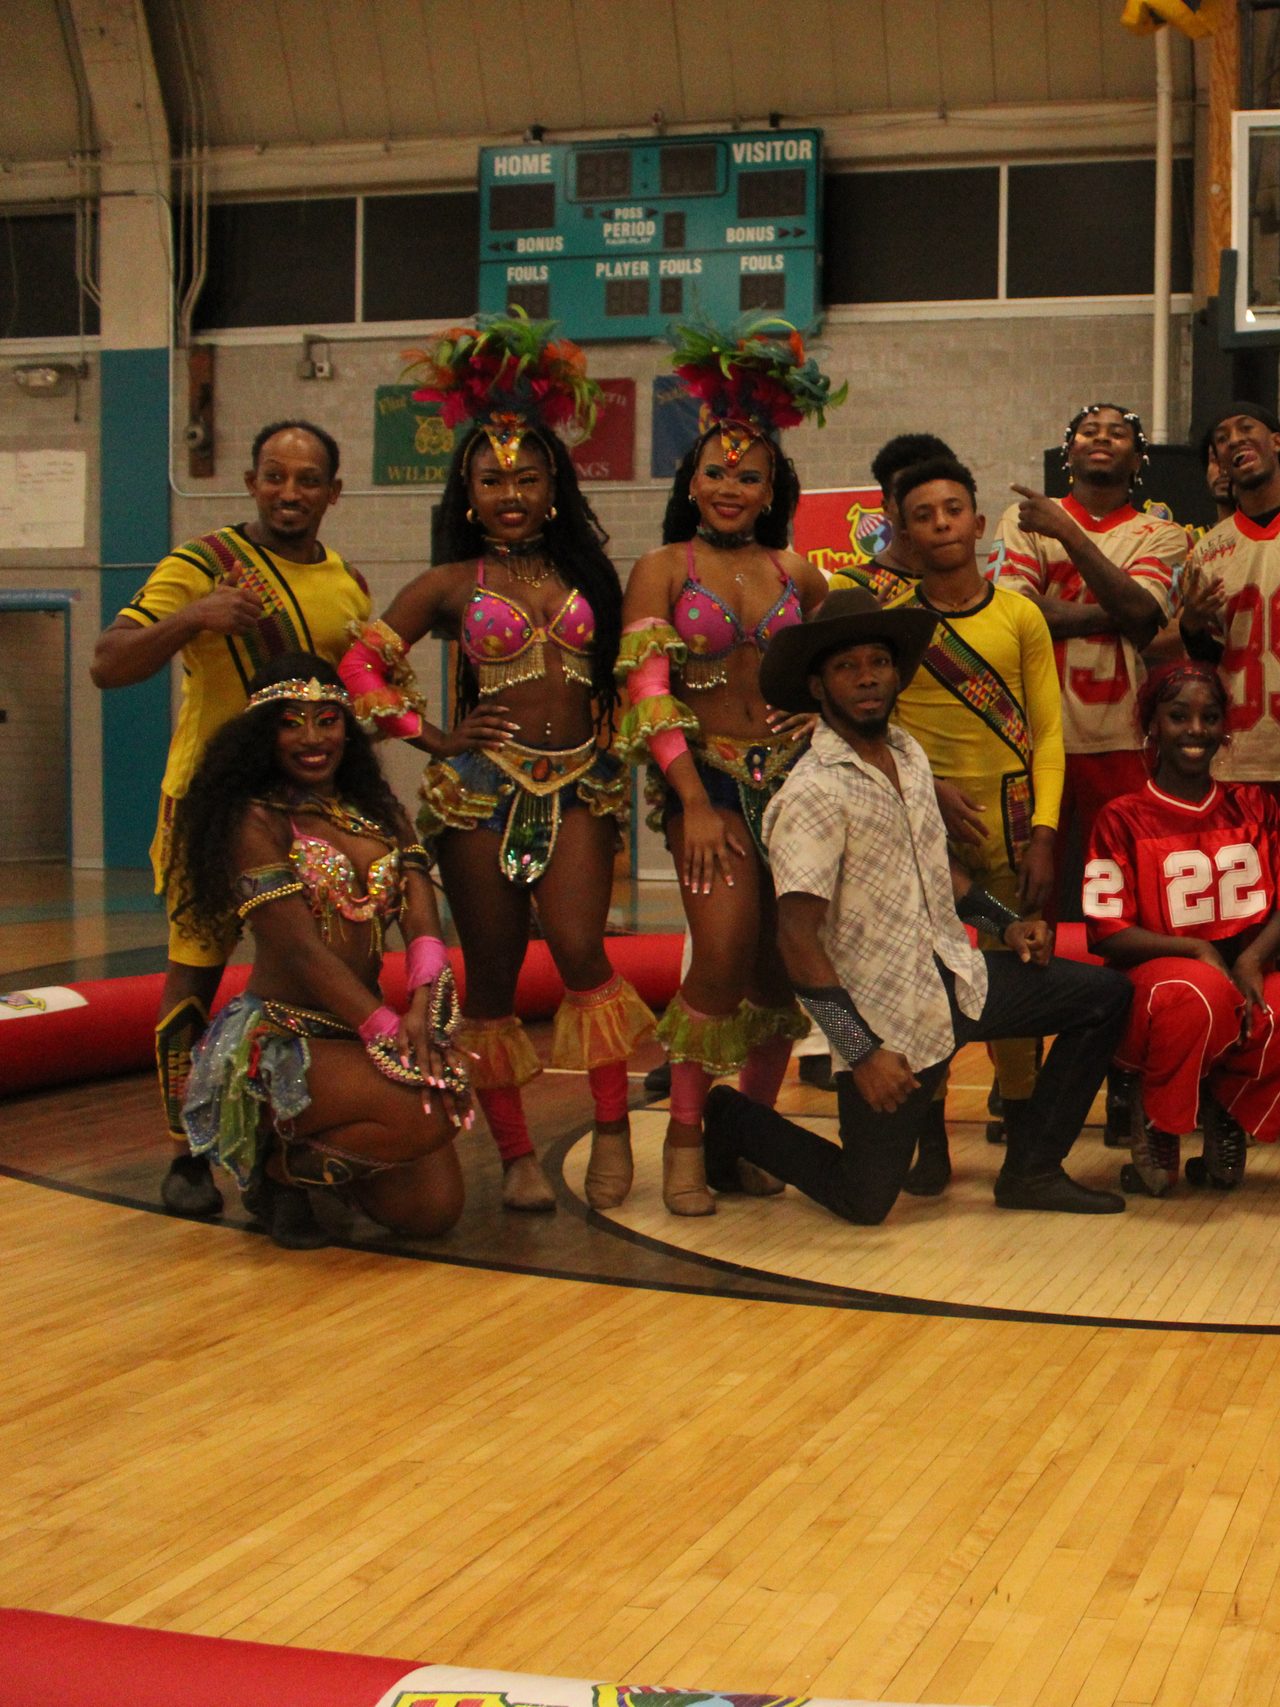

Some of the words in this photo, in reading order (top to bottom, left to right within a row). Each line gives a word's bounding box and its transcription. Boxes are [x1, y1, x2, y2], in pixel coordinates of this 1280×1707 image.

[731, 139, 813, 164] VISITOR
[494, 153, 552, 177] HOME
[603, 220, 656, 238] PERIOD
[725, 226, 775, 243] BONUS
[516, 236, 564, 254] BONUS
[595, 260, 649, 279] PLAYER
[659, 258, 702, 275] FOULS
[740, 254, 785, 272] FOULS
[507, 265, 549, 282] FOULS
[1082, 858, 1124, 919] 2
[1163, 842, 1266, 928] 22
